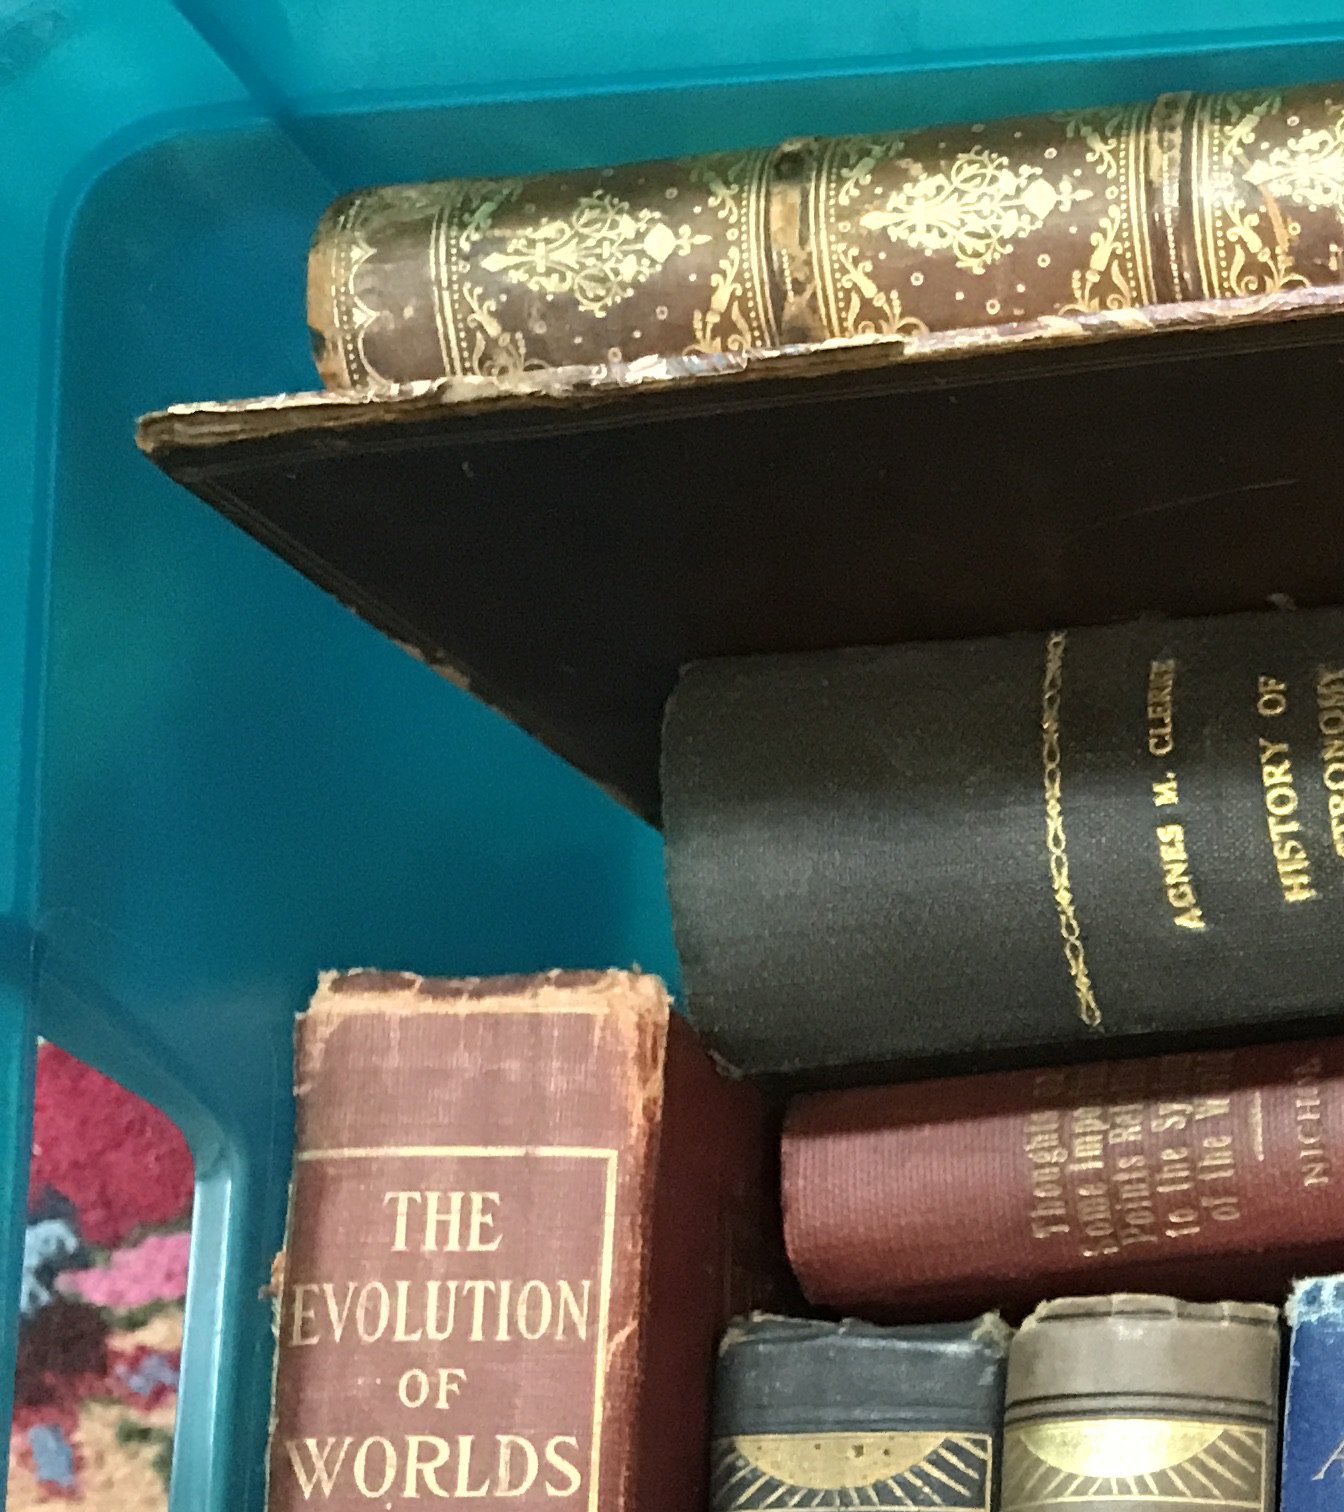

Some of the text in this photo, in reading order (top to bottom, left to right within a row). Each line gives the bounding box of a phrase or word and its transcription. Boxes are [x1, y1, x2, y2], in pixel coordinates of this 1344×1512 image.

[1151, 771, 1179, 806] M.
[1257, 675, 1318, 903] HISTORY OF
[1156, 824, 1206, 931] AGNES
[1155, 1146, 1194, 1193] the
[1198, 1136, 1234, 1180] the
[384, 1191, 503, 1252] THE
[1111, 1154, 1158, 1246] Points
[1200, 1196, 1241, 1221] of
[287, 1279, 591, 1347] EVOLUTION
[398, 1367, 468, 1410] OF
[285, 1434, 583, 1500] WORLDS
